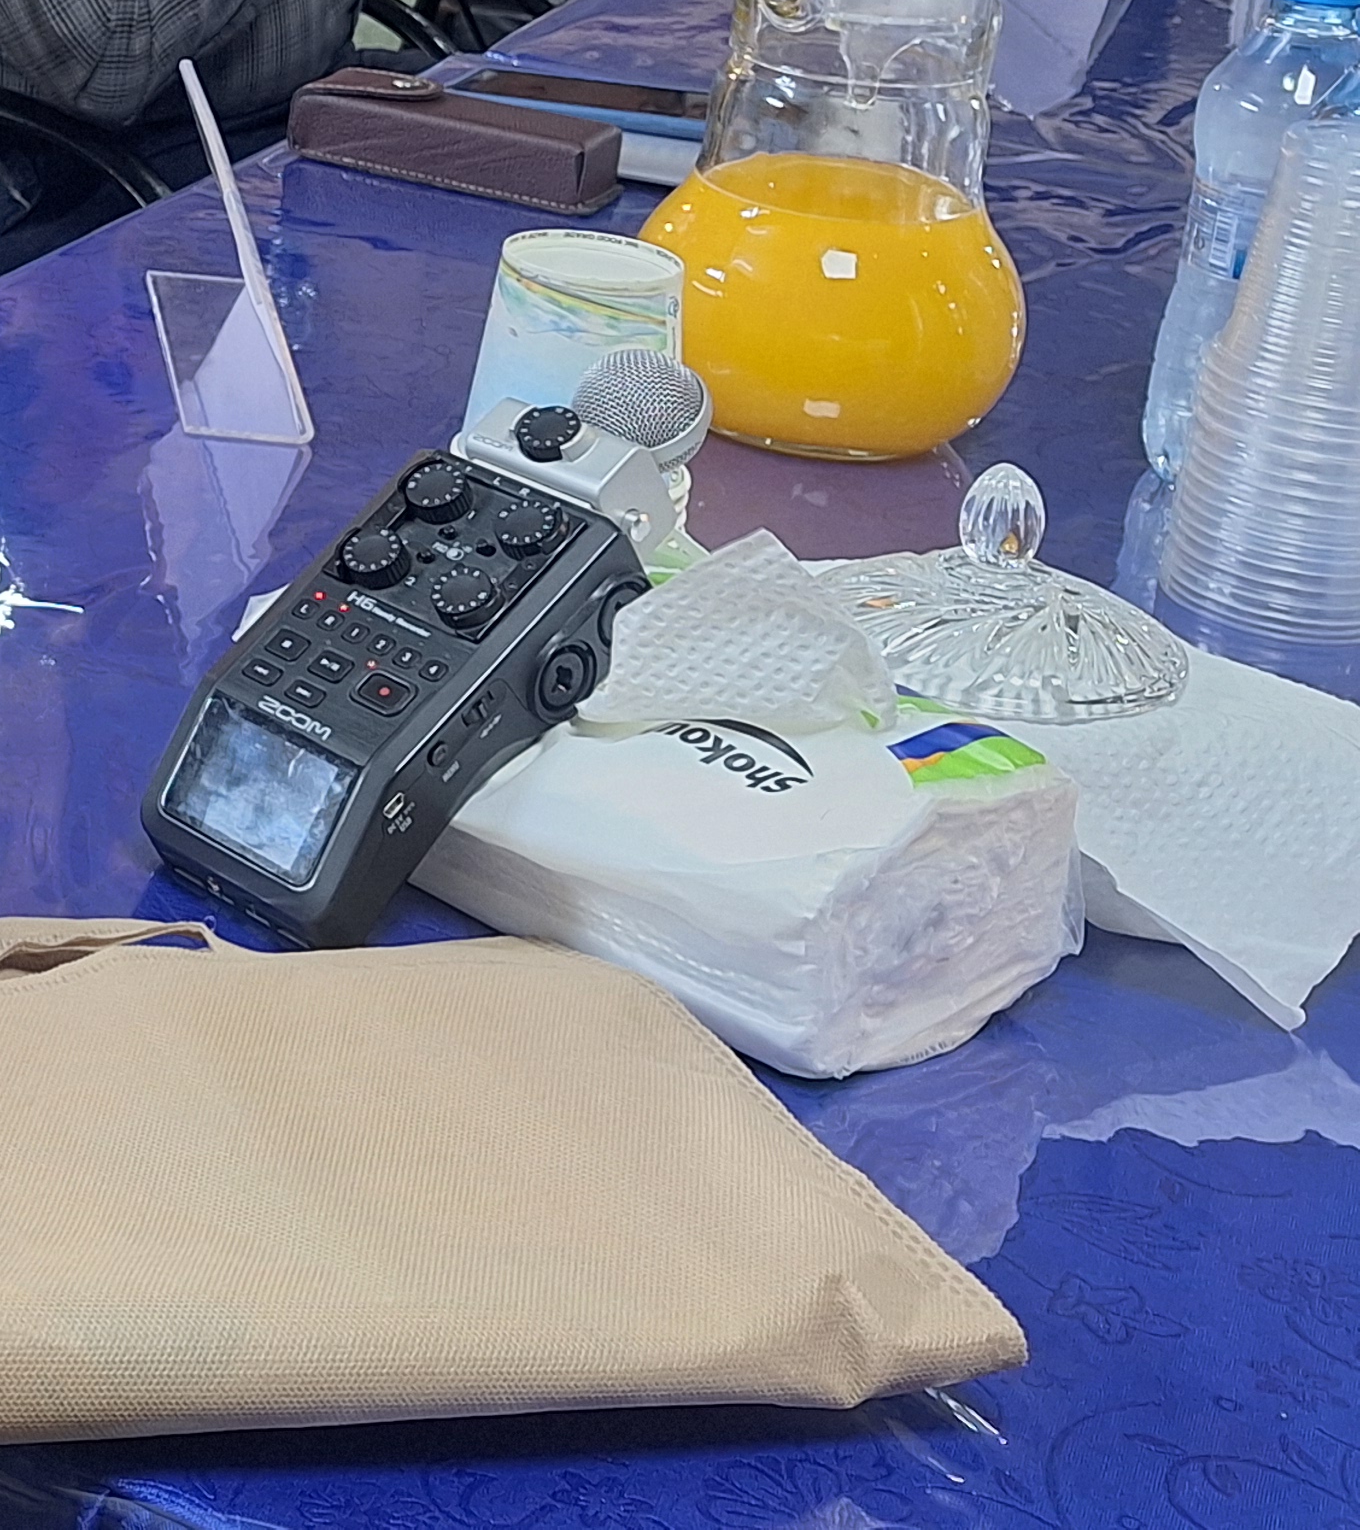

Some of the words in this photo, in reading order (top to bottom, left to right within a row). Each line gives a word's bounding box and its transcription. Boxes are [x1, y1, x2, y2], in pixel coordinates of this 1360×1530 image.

[405, 575, 417, 587] 2
[346, 590, 374, 612] H6
[374, 638, 386, 650] 2
[400, 651, 412, 663] 3
[257, 694, 333, 742] ZOOM
